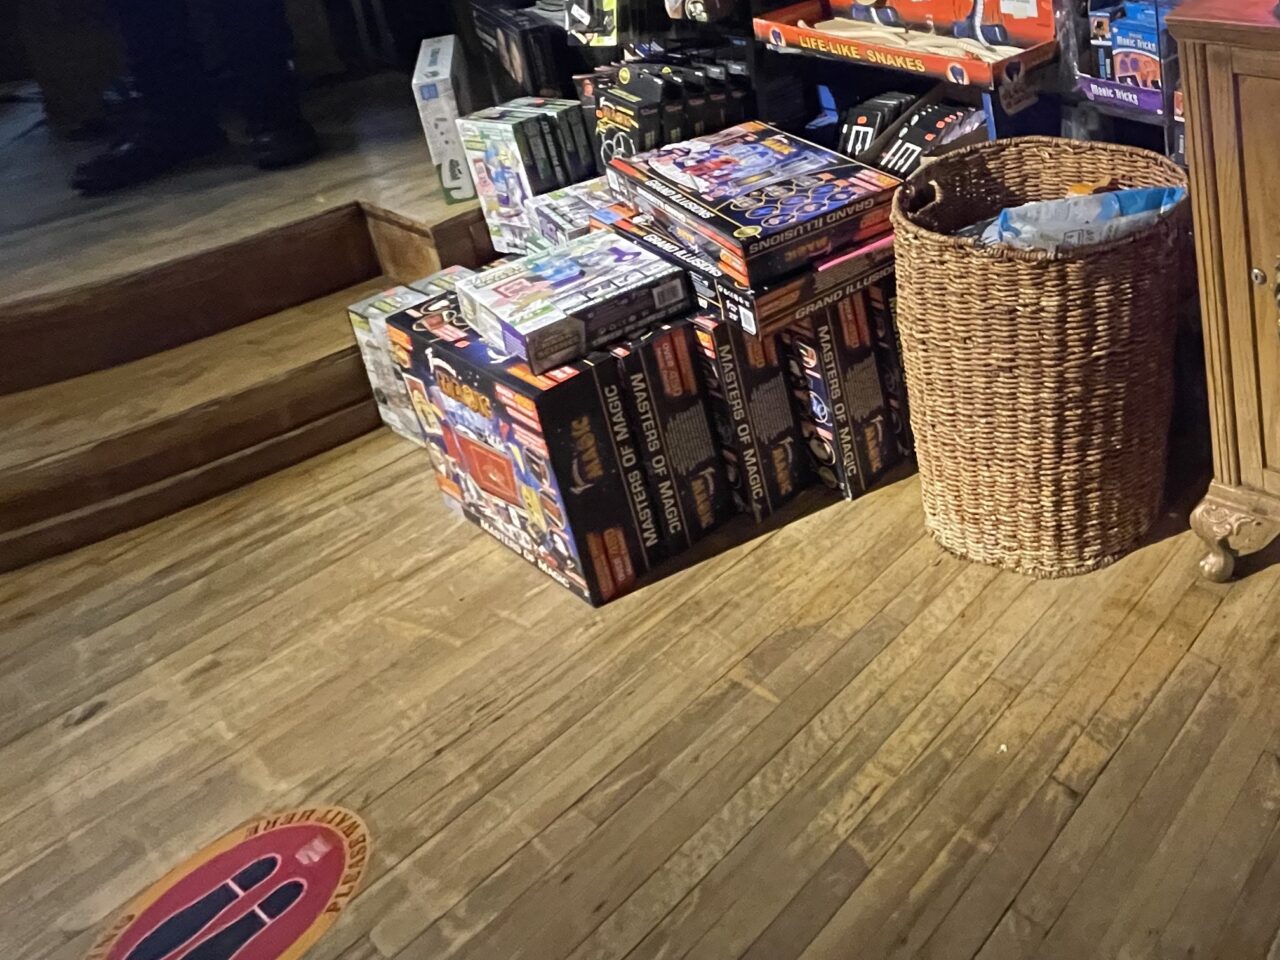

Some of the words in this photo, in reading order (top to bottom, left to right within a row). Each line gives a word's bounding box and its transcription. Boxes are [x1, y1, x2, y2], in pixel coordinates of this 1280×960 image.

[799, 36, 861, 59] LIFE-LIKE
[866, 50, 926, 72] SNAKES
[1115, 88, 1138, 106] Tricks
[644, 179, 677, 198] GRAND
[826, 197, 874, 222] GRAND
[643, 234, 680, 254] GRAND
[748, 219, 823, 254] ILLUSIONS
[795, 288, 843, 320] GRAND
[662, 342, 674, 368] OVER
[718, 344, 745, 422] MASTERS
[603, 386, 630, 442] MAGIC
[630, 372, 660, 451] MASTERS
[817, 325, 842, 401] MASTERS
[832, 403, 848, 424] OF
[840, 426, 857, 477] MAGIC
[737, 424, 752, 447] OF
[619, 445, 637, 467] OF
[651, 454, 667, 477] OF
[743, 449, 763, 501] MAGIC
[627, 472, 659, 548] MASTERS
[658, 480, 682, 536] MAGIC
[245, 809, 317, 840] HERE
[319, 808, 361, 838] WAIT
[326, 834, 368, 915] PLEASE
